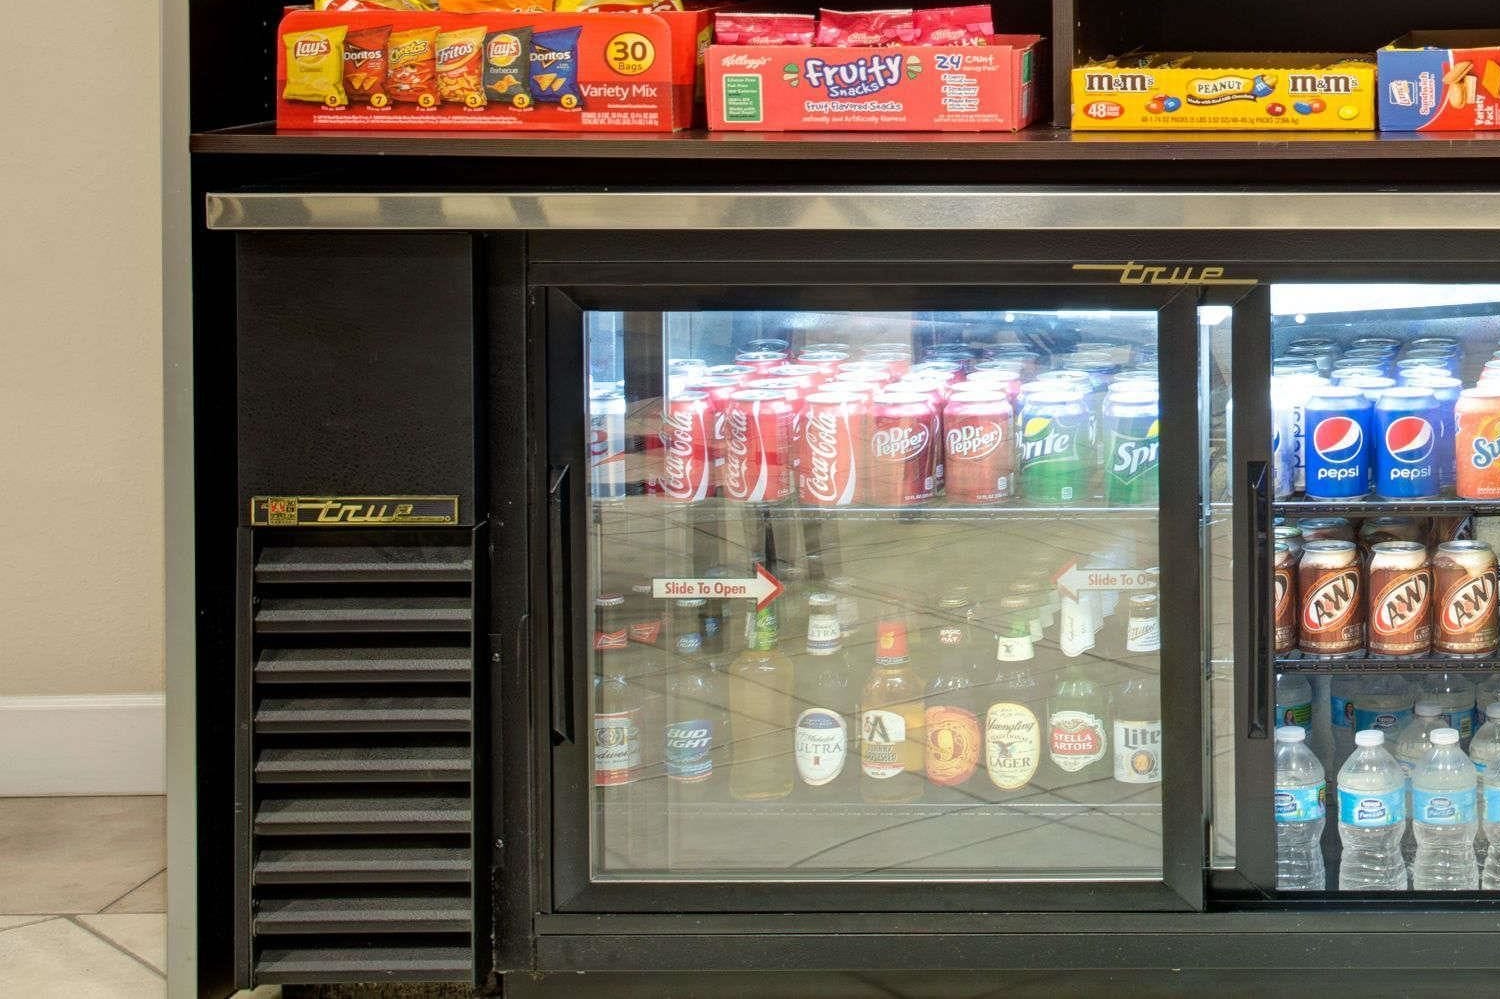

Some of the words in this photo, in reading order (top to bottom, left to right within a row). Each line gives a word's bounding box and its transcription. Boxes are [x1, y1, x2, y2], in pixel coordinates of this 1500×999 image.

[296, 40, 329, 58] Lay's
[344, 50, 382, 61] Doritos
[391, 41, 429, 62] Cheetos
[439, 43, 473, 63] Fritos
[489, 41, 518, 57] Lay's
[530, 51, 571, 62] Doritos
[614, 41, 647, 62] 30
[618, 62, 643, 72] Bags
[721, 54, 771, 68] Kellogg's
[936, 55, 961, 69] 24
[805, 55, 902, 87] Fruity
[580, 83, 630, 101] Variety
[633, 83, 657, 97] Mix
[829, 83, 880, 97] Snacks
[1198, 80, 1242, 94] PEANUT
[1419, 72, 1430, 115] Sandwich
[1088, 104, 1106, 117] 48
[1475, 95, 1486, 126] Variety
[1119, 261, 1225, 285] true
[889, 427, 911, 442] Dr
[964, 425, 984, 441] Dr
[875, 431, 927, 456] Pepper
[949, 430, 998, 455] Pepper
[1114, 440, 1159, 476] Spr
[1318, 465, 1359, 480] pepsi
[1391, 465, 1431, 480] pepsi
[317, 500, 414, 522] true
[1088, 573, 1117, 586] Slide
[1120, 573, 1134, 586] To
[665, 583, 696, 595] Slide
[697, 583, 711, 595] To
[714, 584, 747, 597] Open
[1053, 732, 1092, 743] STELLA
[1123, 728, 1160, 749] Lite
[1054, 742, 1093, 751] ARTOIS
[990, 757, 1032, 768] LAGER
